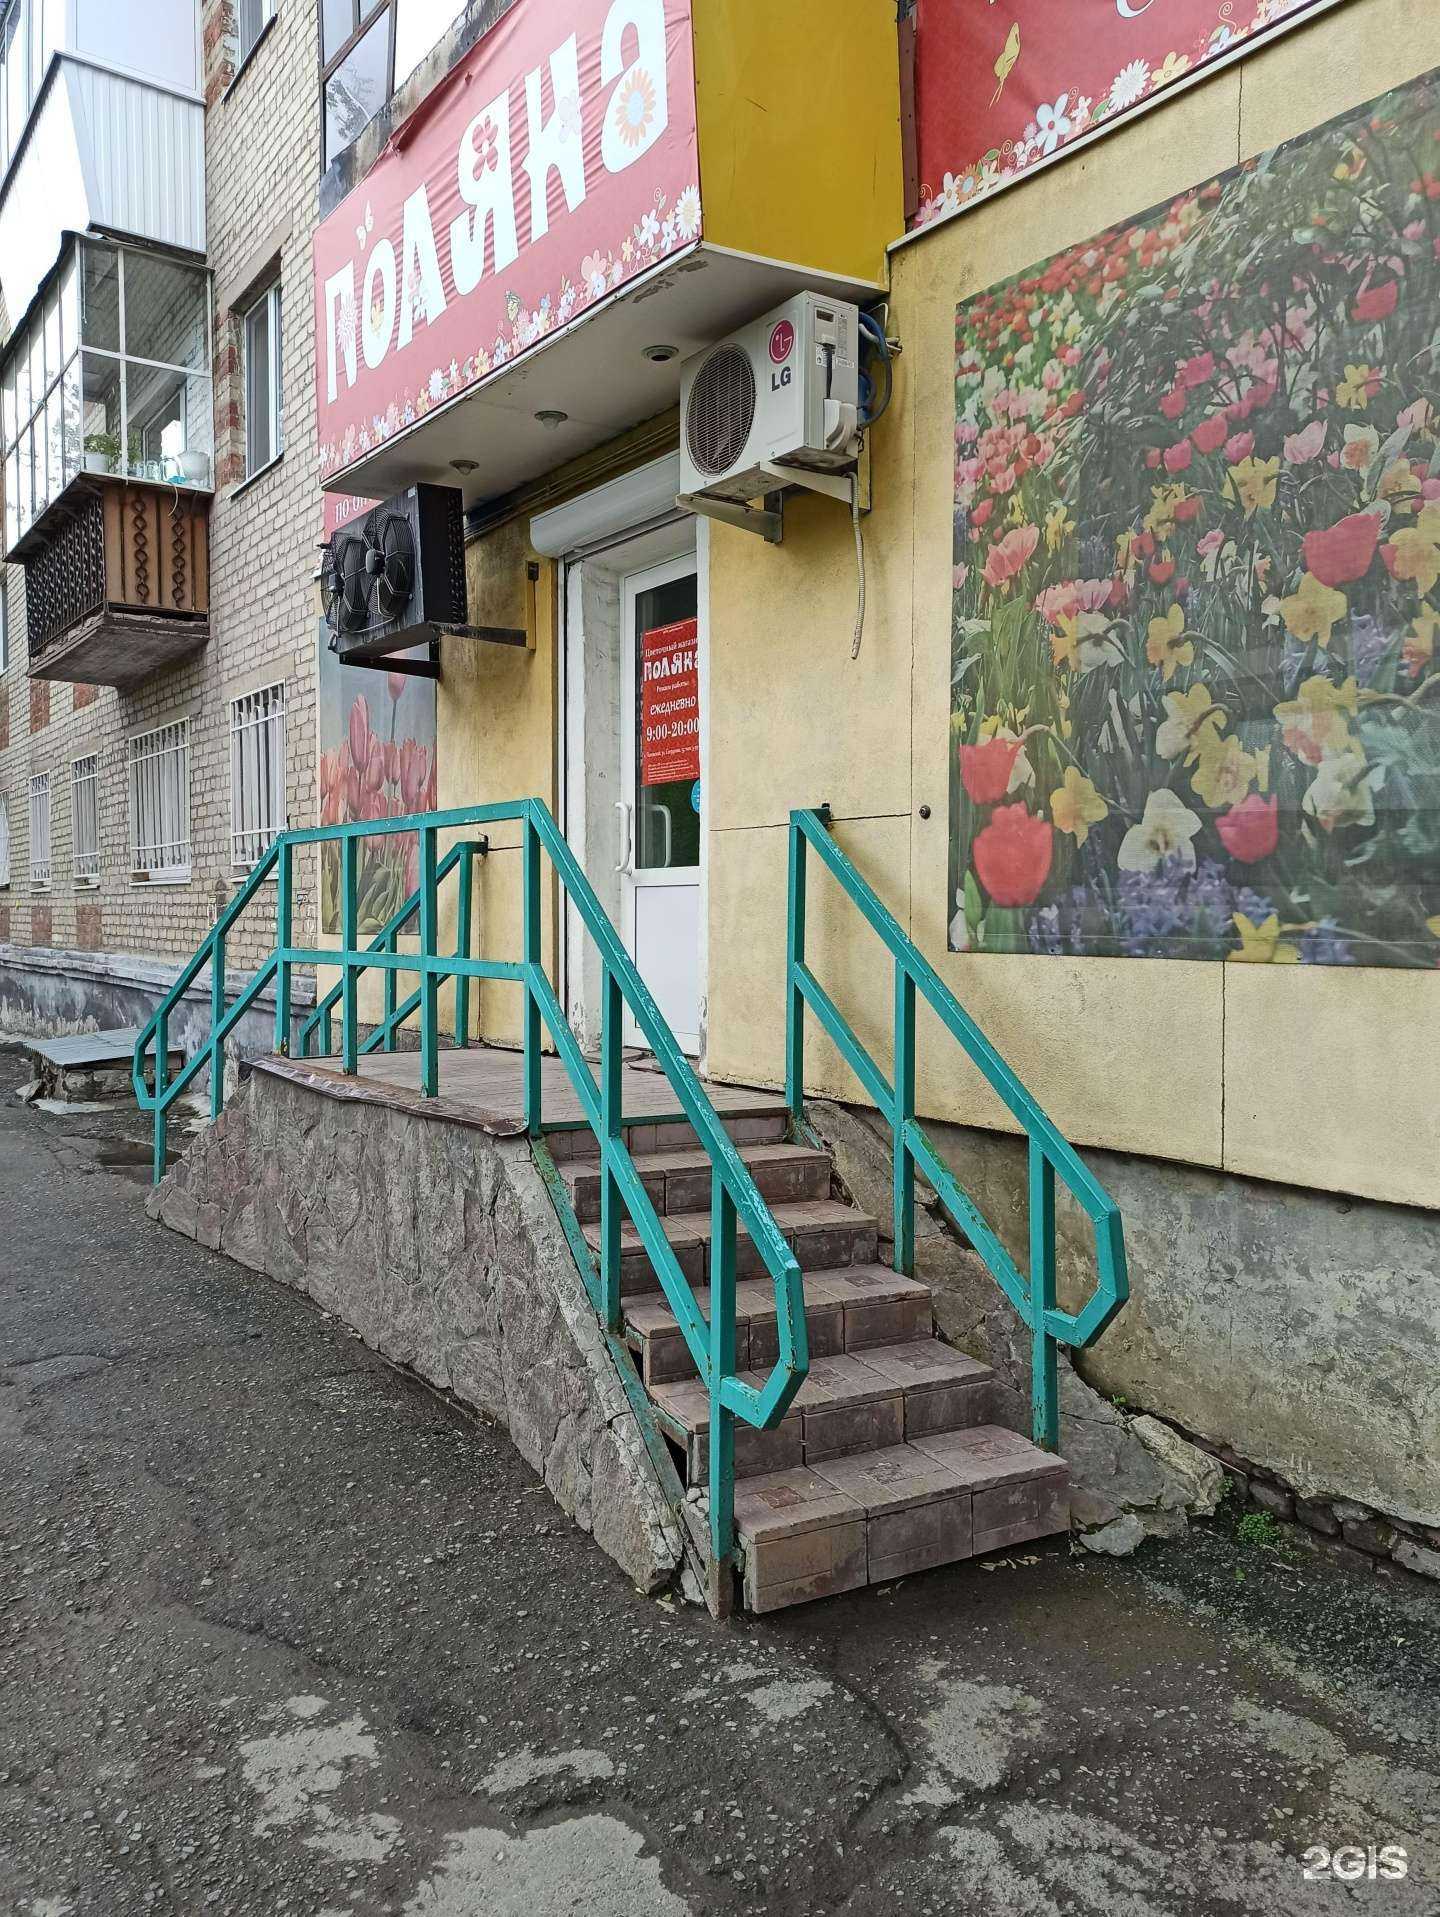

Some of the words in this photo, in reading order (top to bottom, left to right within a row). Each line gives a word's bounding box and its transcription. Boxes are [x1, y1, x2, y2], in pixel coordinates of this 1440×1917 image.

[771, 366, 792, 392] LG
[650, 695, 697, 718] ежедневно
[646, 717, 700, 742] 9:00-20:00
